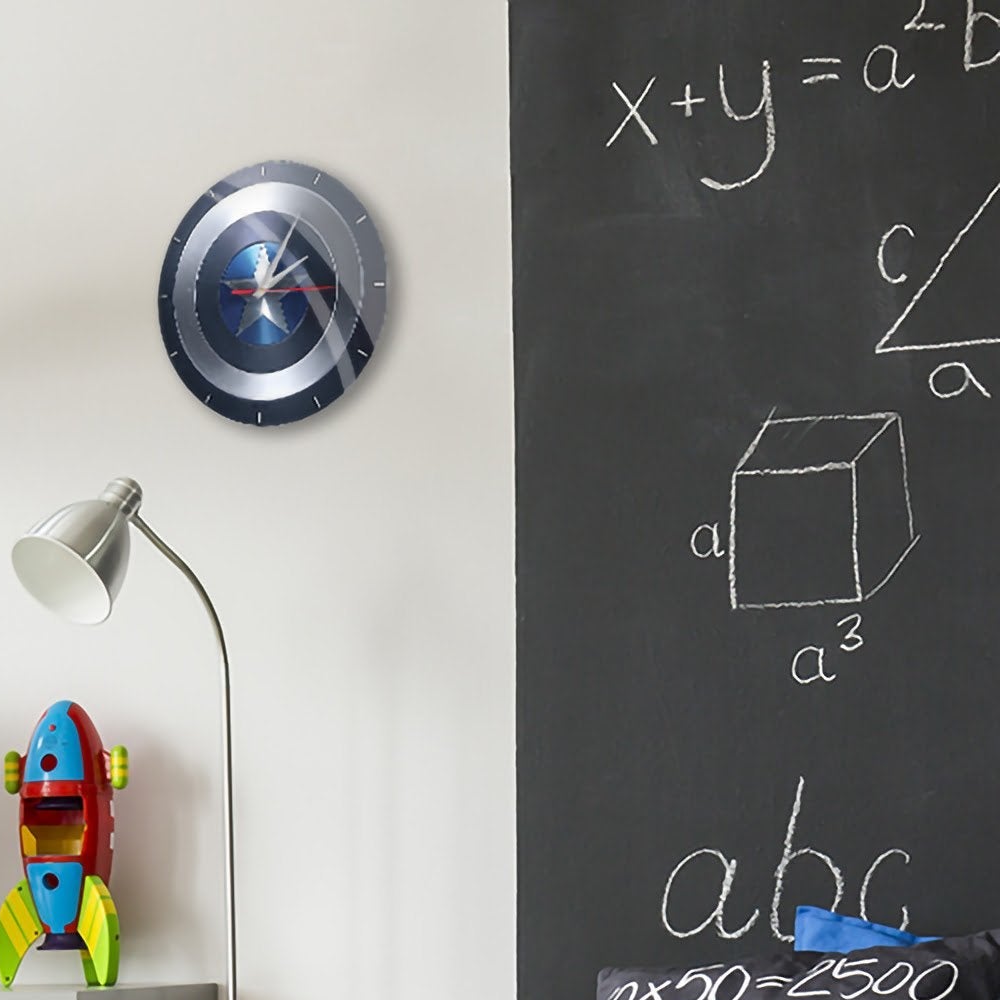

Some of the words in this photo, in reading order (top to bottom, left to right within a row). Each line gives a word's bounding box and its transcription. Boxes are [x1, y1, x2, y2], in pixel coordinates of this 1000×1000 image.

[877, 224, 915, 284] c
[928, 361, 992, 399] a
[690, 523, 725, 558] a
[661, 776, 910, 943] abc
